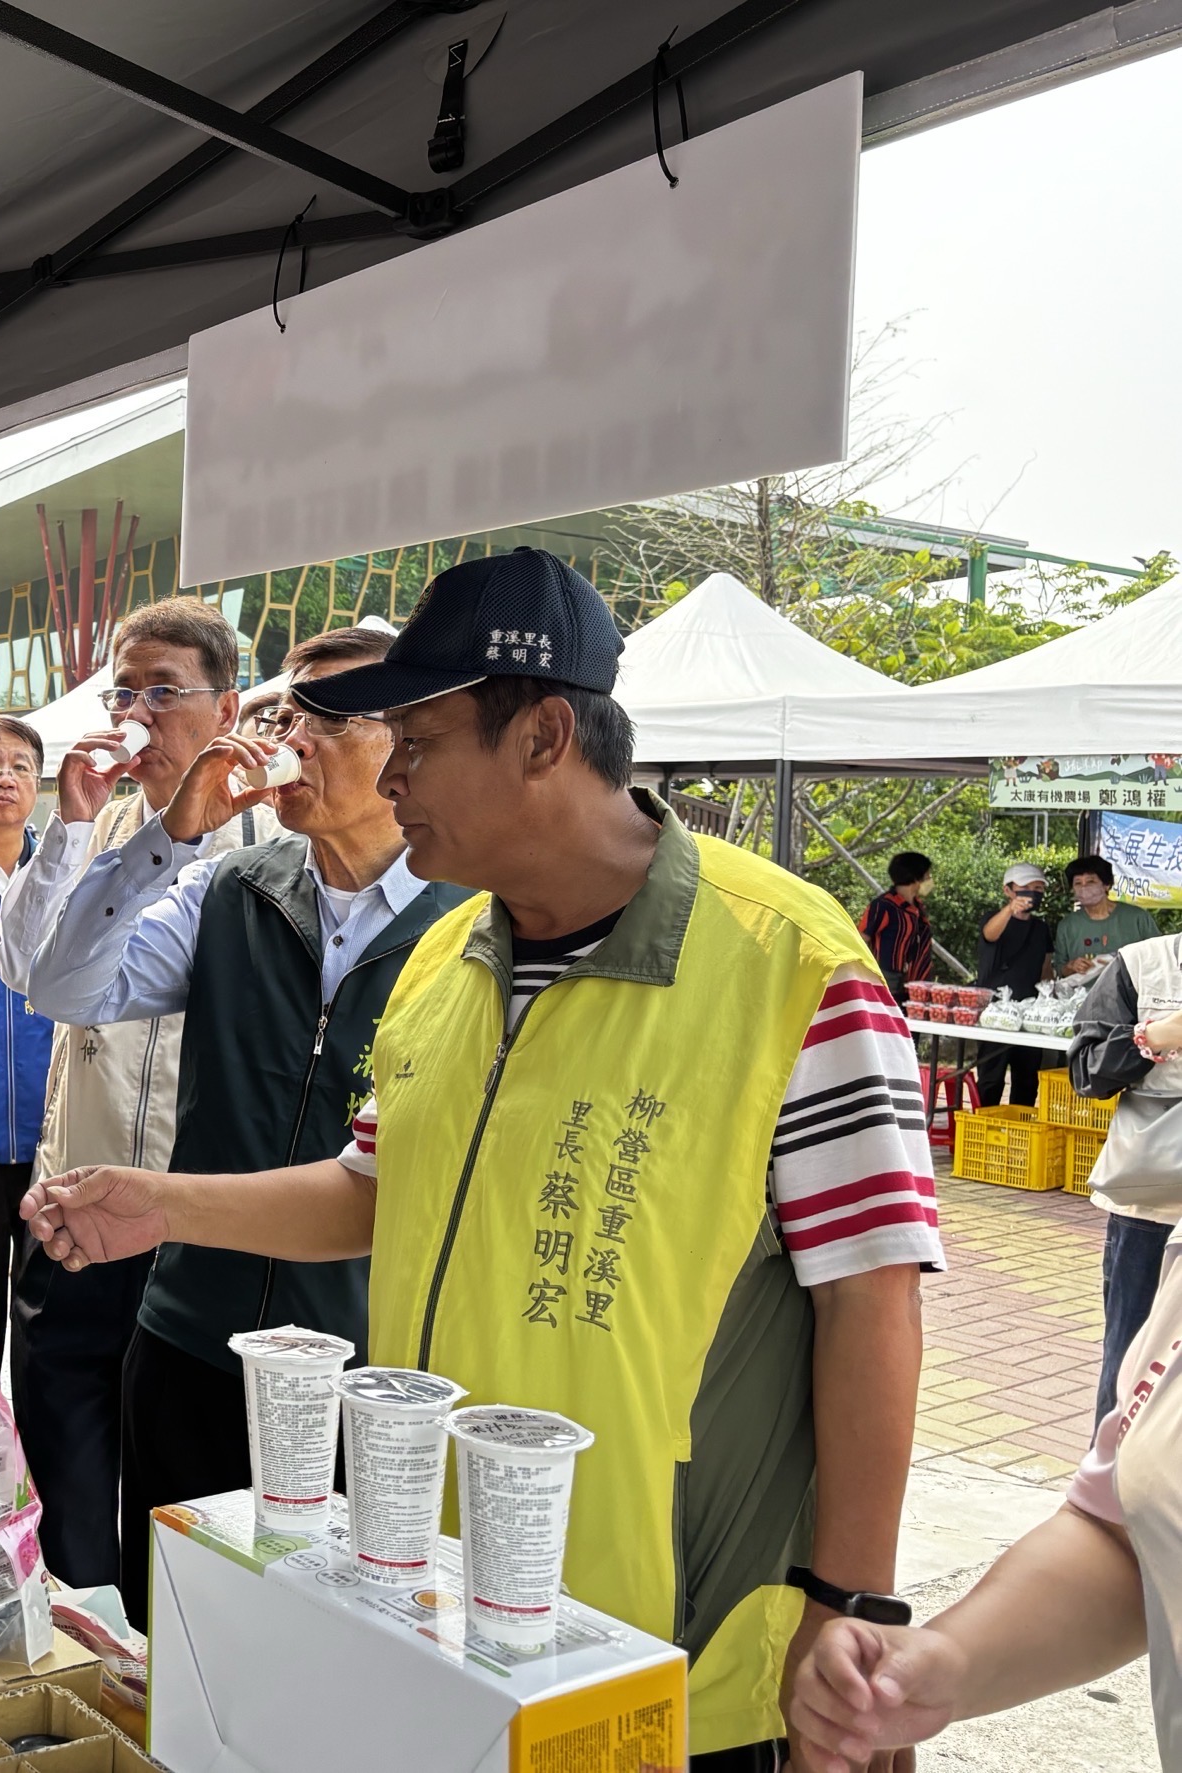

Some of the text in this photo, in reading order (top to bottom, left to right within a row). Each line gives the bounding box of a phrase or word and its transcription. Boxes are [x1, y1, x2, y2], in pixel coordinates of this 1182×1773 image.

[489, 629, 553, 650] 重溪里長
[485, 646, 553, 668] 蔡明宏
[1010, 788, 1167, 807] 太康有機農場 鄭鴻權
[576, 1088, 667, 1333] 柳營區重溪里
